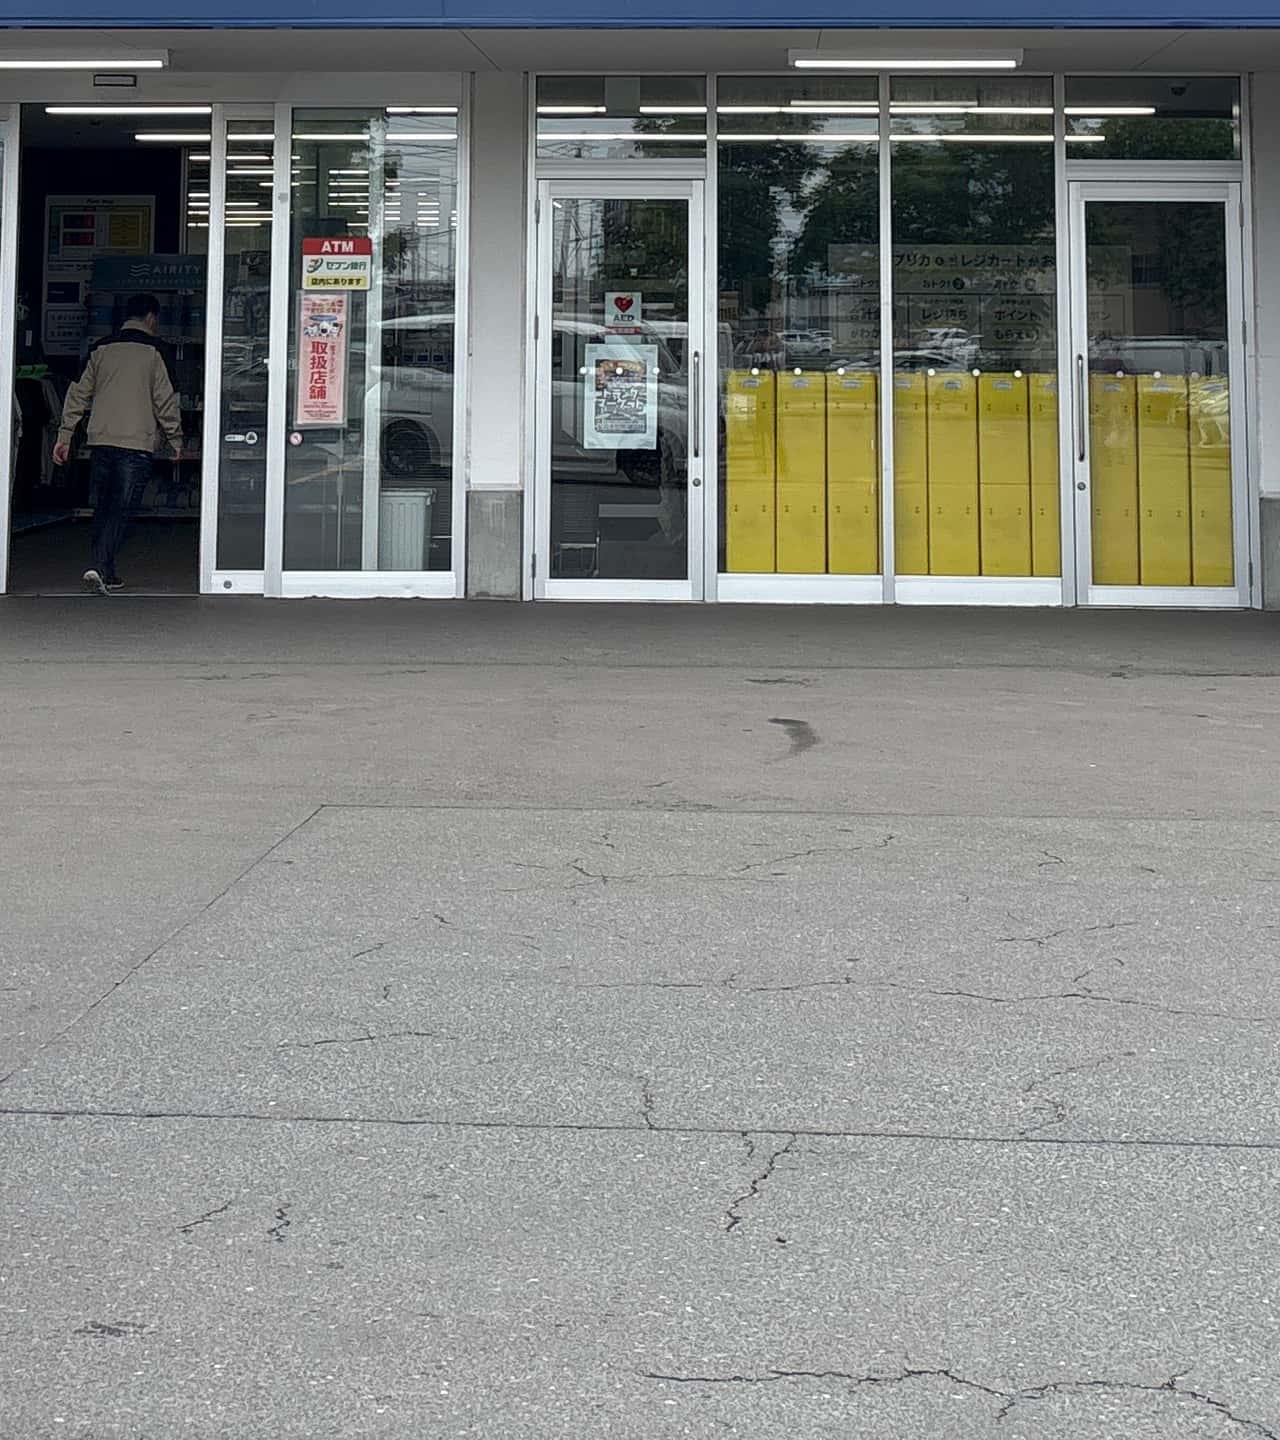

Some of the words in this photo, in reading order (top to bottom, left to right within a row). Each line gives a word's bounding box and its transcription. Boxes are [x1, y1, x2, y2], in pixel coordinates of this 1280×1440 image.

[321, 240, 354, 253] ATM
[326, 261, 367, 271] セブン銀行
[311, 277, 362, 286] 店内にあります
[613, 313, 635, 322] AED
[309, 341, 328, 400] 取扱店舗
